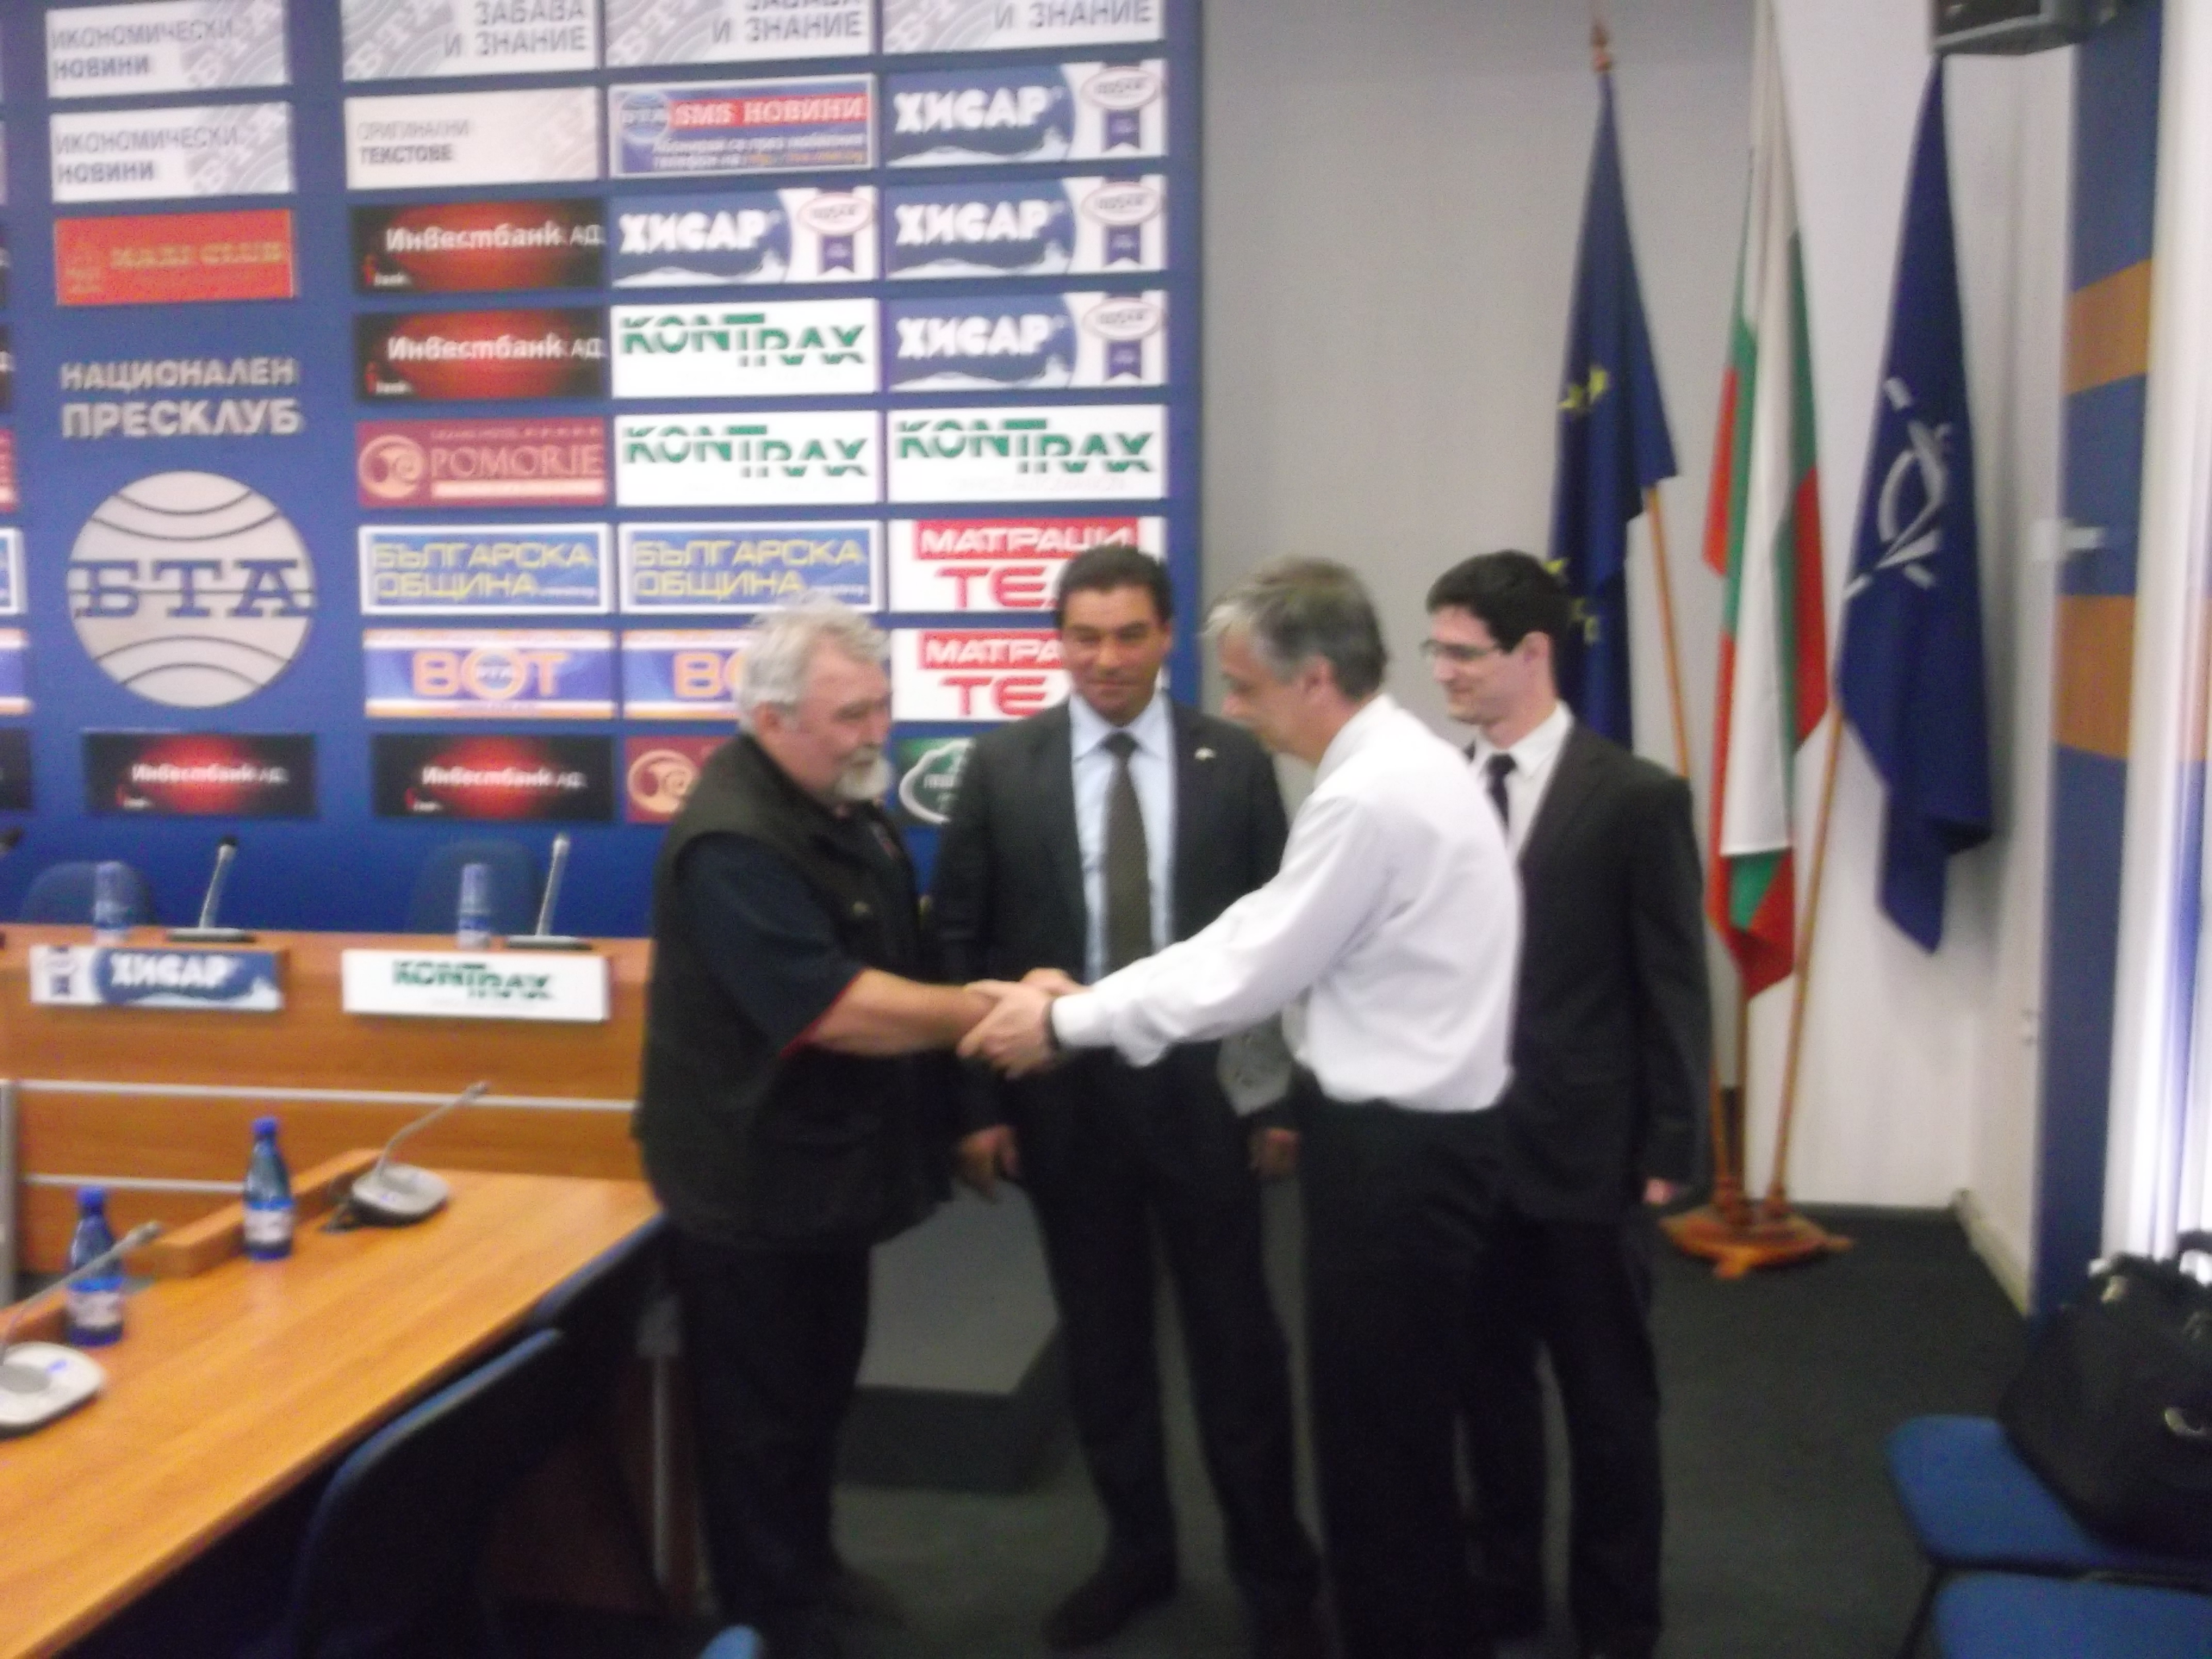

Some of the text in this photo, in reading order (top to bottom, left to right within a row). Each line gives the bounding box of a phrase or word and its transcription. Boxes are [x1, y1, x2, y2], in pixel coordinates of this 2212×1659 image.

[712, 19, 731, 43] И
[745, 11, 863, 42] ЗНАНИЕ
[994, 0, 1153, 29] И ЗНАНИЕ
[51, 19, 235, 48] ИКОНОМИЧЕСКИ
[444, 33, 463, 58] И
[475, 25, 587, 57] ЗНАНИЕ
[53, 56, 150, 80] НОВИНИ
[743, 96, 865, 123] НОВИНИ
[893, 85, 1050, 133] ХИСАР
[55, 127, 239, 154] ИКОНОМИЧЕСКИ
[56, 162, 155, 185] НОВИНИ
[619, 208, 767, 255] ХИСАР
[894, 199, 1050, 246] ХИСАР
[621, 313, 867, 367] KONTRAX
[897, 314, 1050, 359] ХИСАР
[60, 357, 297, 392] НАЦИОНАЛЕН
[61, 399, 303, 438] ПРЕСКЛУБ
[622, 424, 870, 478] KONTRAX
[897, 418, 1154, 474] KONTRAX
[373, 542, 596, 567] БЪЛГАРСКА
[632, 539, 865, 566] БЪЛГАРСКА
[375, 573, 540, 600] ОБЩИНА
[633, 571, 808, 600] ОБЩИНА
[936, 566, 1059, 610] ТЕ
[926, 640, 1063, 663] МАТРА
[942, 676, 1047, 717] ТЕ
[109, 953, 230, 987] ХИСАР
[393, 961, 553, 1000] KONTRAX
